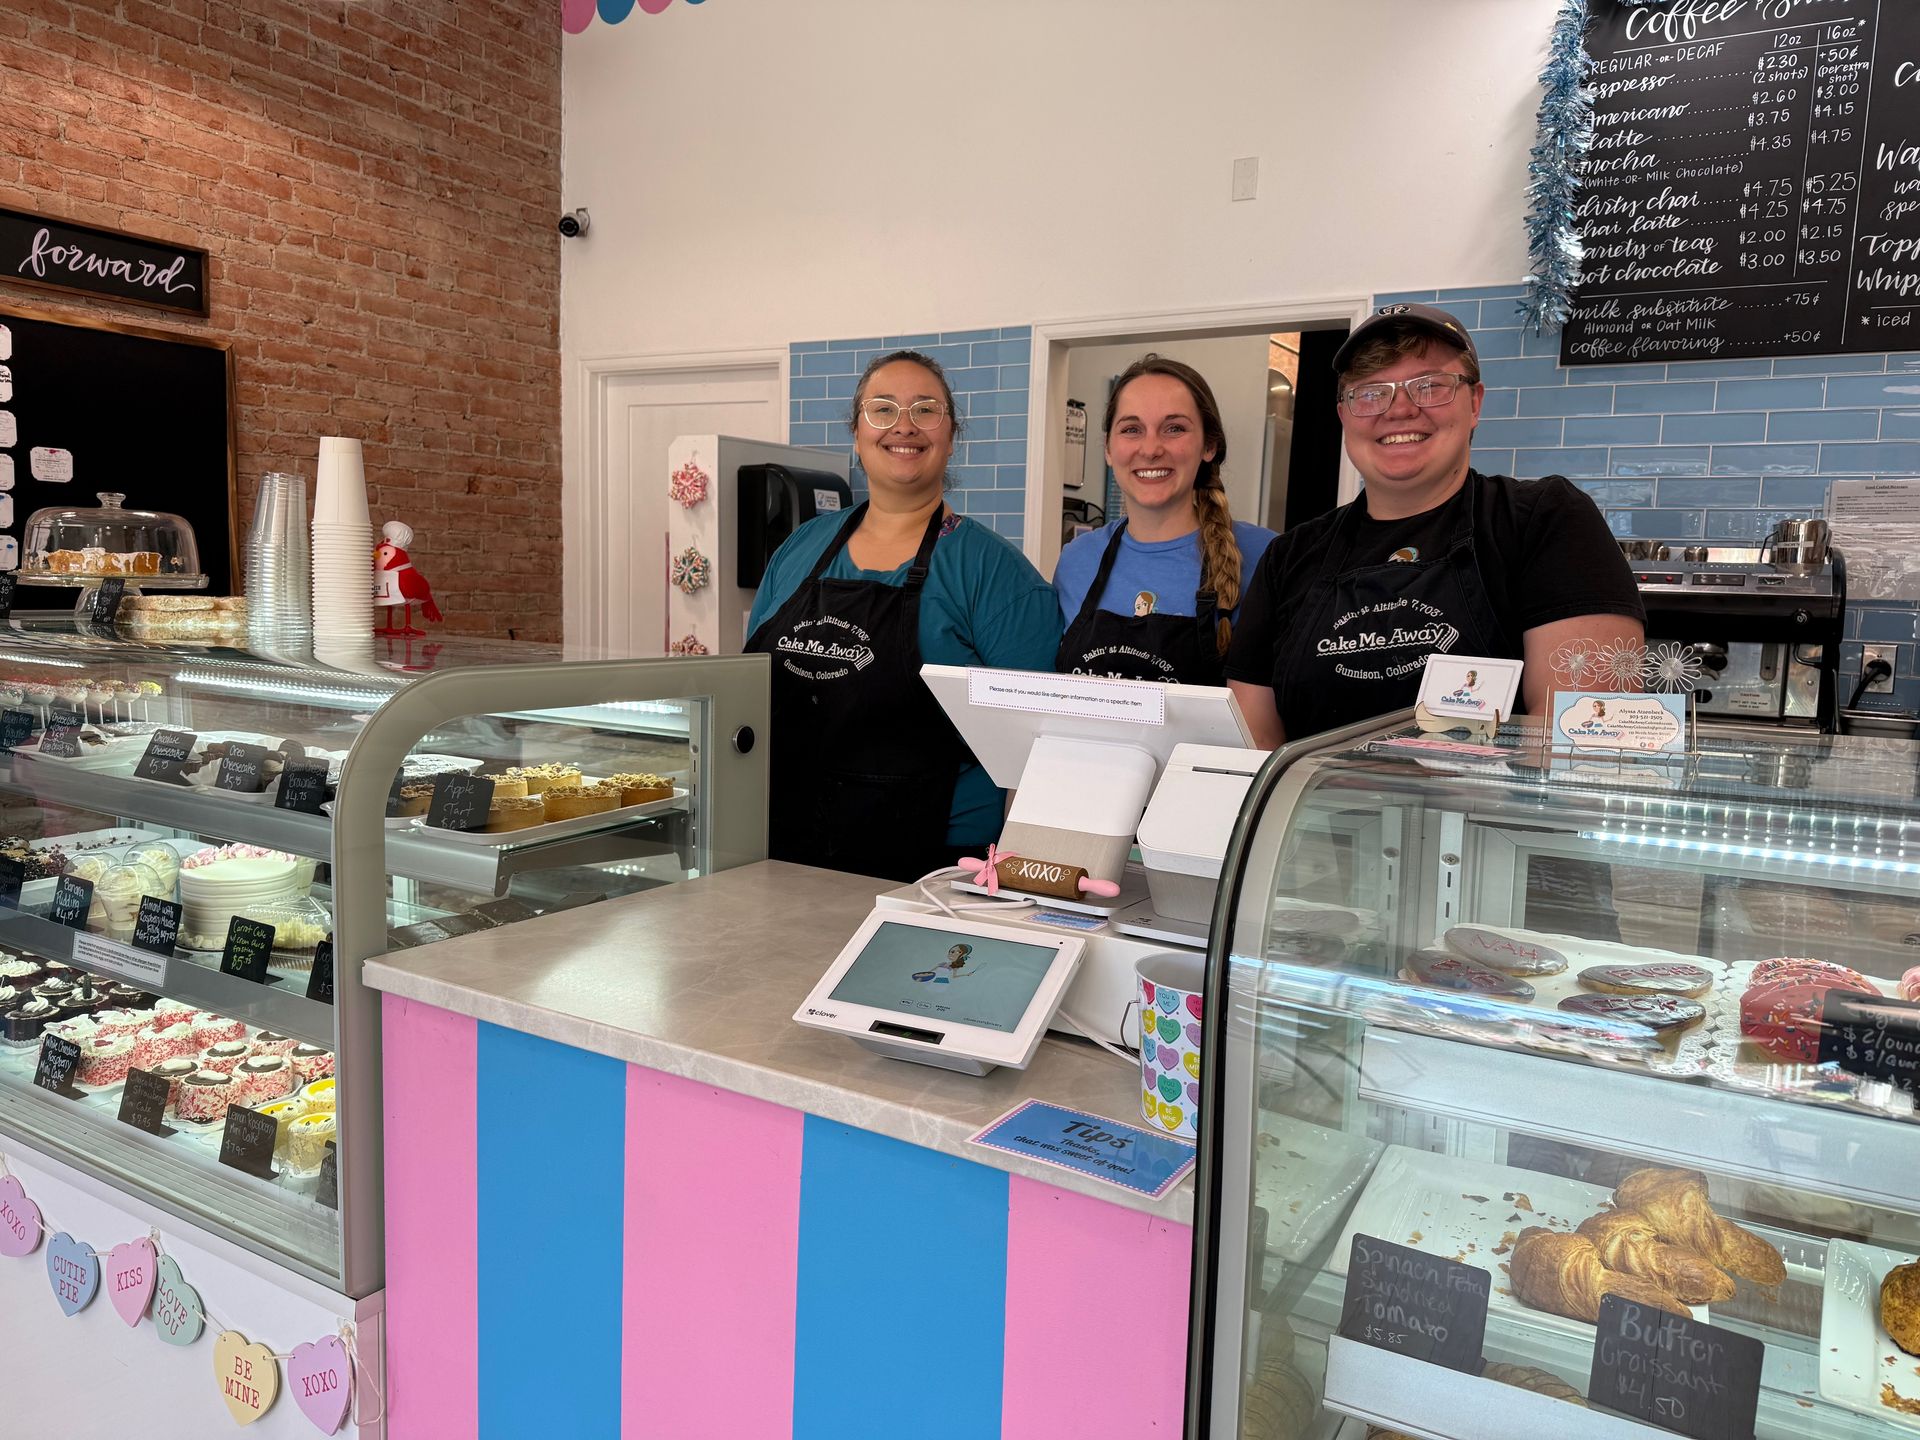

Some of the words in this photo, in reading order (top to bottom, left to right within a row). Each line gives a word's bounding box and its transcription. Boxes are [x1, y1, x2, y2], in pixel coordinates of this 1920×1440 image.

[1626, 0, 1748, 42] Coffee
[1773, 33, 1801, 48] 12oz
[1591, 53, 1652, 75] REGULAR
[1677, 42, 1725, 62] DECAF
[1758, 54, 1797, 71] $2.30
[1819, 45, 1859, 62] +50¢
[1769, 66, 1809, 82] shots)
[1829, 71, 1858, 84] shot)
[1585, 102, 1690, 131] Americano
[1752, 89, 1797, 104] $2.60
[1817, 82, 1859, 99] $3.00
[1748, 109, 1790, 127] $3.75
[1814, 102, 1854, 118] $4.15
[1580, 150, 1660, 176] mocha
[1750, 134, 1792, 151] $4.35
[1810, 128, 1852, 145] $4.75
[1646, 171, 1670, 182] Milk
[1676, 160, 1744, 179] Chocolate)
[1577, 195, 1644, 218] dirty
[1646, 186, 1700, 210] chai
[1744, 178, 1793, 197] $4.75
[1805, 172, 1857, 194] $5.25
[1575, 219, 1621, 238] chai
[1626, 214, 1689, 234] latte
[1739, 200, 1789, 220] $4.25
[1802, 197, 1846, 215] $4.75
[1739, 229, 1786, 245] $2.00
[1801, 224, 1843, 240] $2.15
[18, 227, 196, 293] forward
[1583, 238, 1651, 260] ariety
[1654, 244, 1665, 252] OF
[1665, 236, 1719, 255] teas
[1615, 258, 1723, 281] chocolate
[1739, 252, 1785, 269] $3.00
[1798, 249, 1841, 265] $3.50
[1572, 299, 1621, 320] milk
[1627, 297, 1733, 319] substitute
[1785, 292, 1820, 305] +75¢
[1584, 320, 1634, 335] Almond
[1657, 320, 1681, 332] Oat
[1686, 318, 1716, 331] Milk
[1877, 311, 1911, 327] iced
[1570, 338, 1626, 358] coffee
[1627, 337, 1724, 357] flavoring
[1783, 331, 1821, 343] +50¢
[1360, 605, 1370, 616] at
[1411, 599, 1444, 617] 7,703'
[793, 620, 816, 633] Bakin'
[778, 636, 804, 650] Cake
[805, 640, 825, 653] Me
[825, 643, 865, 661] Away
[1317, 636, 1357, 653] Cake
[1359, 632, 1386, 647] Me
[1388, 626, 1444, 645] Away
[1082, 646, 1107, 662] Bakin'
[1108, 645, 1117, 654] at
[1118, 645, 1151, 660] Altitude
[783, 659, 814, 680] Gunnison,
[816, 668, 848, 680] Colorado
[1335, 663, 1384, 680] Gunnison,
[989, 685, 1005, 693] Please
[1070, 694, 1098, 702] information
[1599, 729, 1621, 738] Away
[152, 745, 185, 760] Cheesecake
[229, 745, 245, 757] Oreo
[222, 758, 256, 775] Cheesecake
[444, 777, 475, 799] Apple
[443, 802, 474, 816] Tart
[1019, 860, 1062, 883] XOXO
[64, 877, 85, 900] Banana
[56, 891, 79, 911] Pudding
[233, 920, 253, 934] Carrot
[252, 927, 267, 939] Cake
[814, 1009, 837, 1019] clover
[47, 1051, 72, 1072] Raspberry
[50, 1067, 65, 1082] Cake
[228, 1107, 246, 1124] Lemon
[247, 1111, 275, 1138] Raspberry
[1062, 1120, 1134, 1149] Tips
[242, 1128, 258, 1145] Cake
[1060, 1138, 1101, 1156] Thanks,
[1013, 1135, 1041, 1146] that
[1040, 1143, 1060, 1153] was
[1061, 1149, 1094, 1162] sweet
[1093, 1158, 1108, 1167] of
[1107, 1162, 1136, 1175] you!
[0, 1200, 26, 1240] XOXO
[53, 1255, 87, 1285] CUTIE
[117, 1267, 143, 1292] KISS
[1447, 1266, 1486, 1298] Feta
[59, 1279, 79, 1303] PIE
[159, 1276, 188, 1325] LOVE
[1362, 1270, 1454, 1316] Sundried
[158, 1299, 179, 1336] YOU
[1354, 1294, 1448, 1342] Tomato
[1364, 1324, 1409, 1344] $5.85
[1620, 1304, 1724, 1365] Butter
[234, 1356, 253, 1381] BE
[1601, 1337, 1725, 1394] Croissant
[225, 1376, 260, 1410] MINE
[302, 1369, 338, 1397] XOXO
